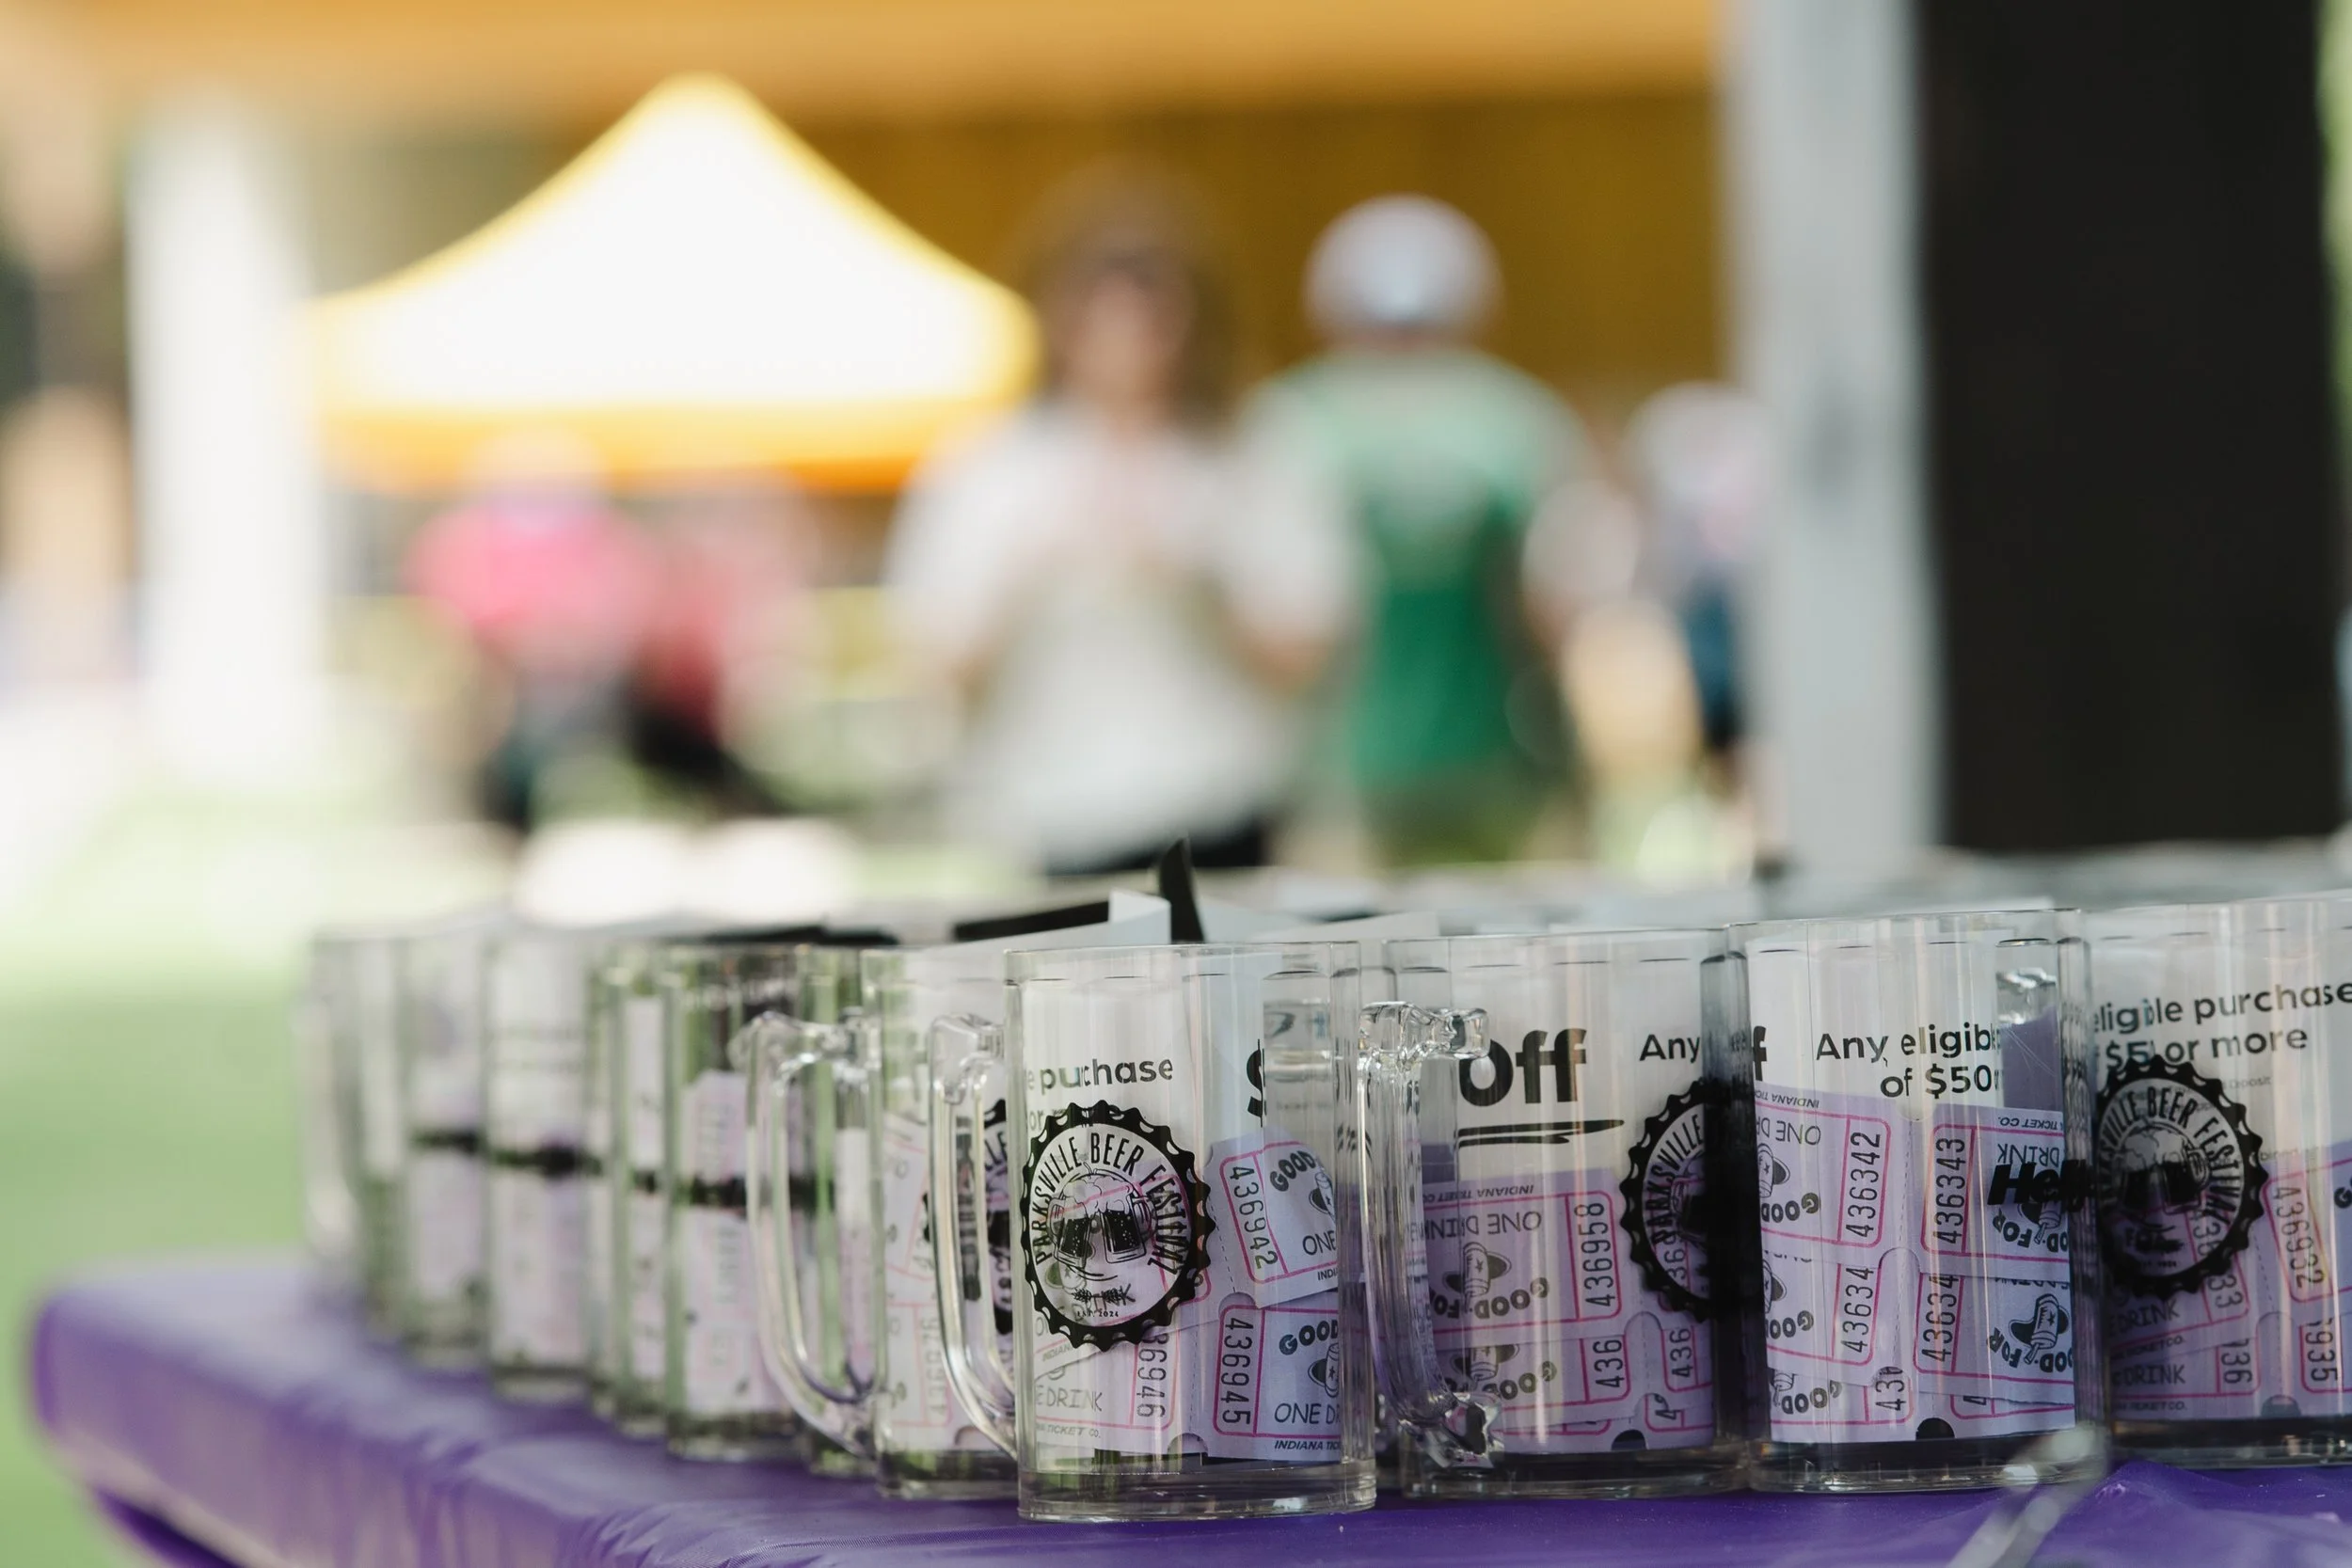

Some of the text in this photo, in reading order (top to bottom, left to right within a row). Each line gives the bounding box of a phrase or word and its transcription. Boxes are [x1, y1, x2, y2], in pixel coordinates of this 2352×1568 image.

[1639, 1034, 1701, 1064] Any
[1816, 1022, 2000, 1064] Any eligib
[2212, 1028, 2308, 1059] more
[1458, 1028, 1587, 1107] Off
[1880, 1063, 1993, 1100] of $50
[1772, 1093, 1820, 1109] INDIANA
[2147, 1085, 2199, 1129] BEER
[1774, 1119, 1821, 1146] ONE
[1090, 1132, 1145, 1176] BEER
[1269, 1149, 1316, 1192] GOOD
[1996, 1143, 2060, 1168] DRINK
[1476, 1184, 1534, 1197] INDIANA
[1845, 1132, 1882, 1238] 436342
[1932, 1137, 1966, 1245] 436343
[1229, 1165, 1279, 1270] 436942
[1486, 1211, 1542, 1236] ONE
[1760, 1192, 1821, 1224] GOOD
[1574, 1202, 1616, 1308] 436958
[1841, 1267, 1874, 1354] 43634
[1921, 1275, 1960, 1363] 43634
[1220, 1317, 1254, 1425] 436945
[1592, 1338, 1626, 1388] 436
[1274, 1402, 1322, 1425] ONE
[1274, 1439, 1324, 1451] INDIANA
